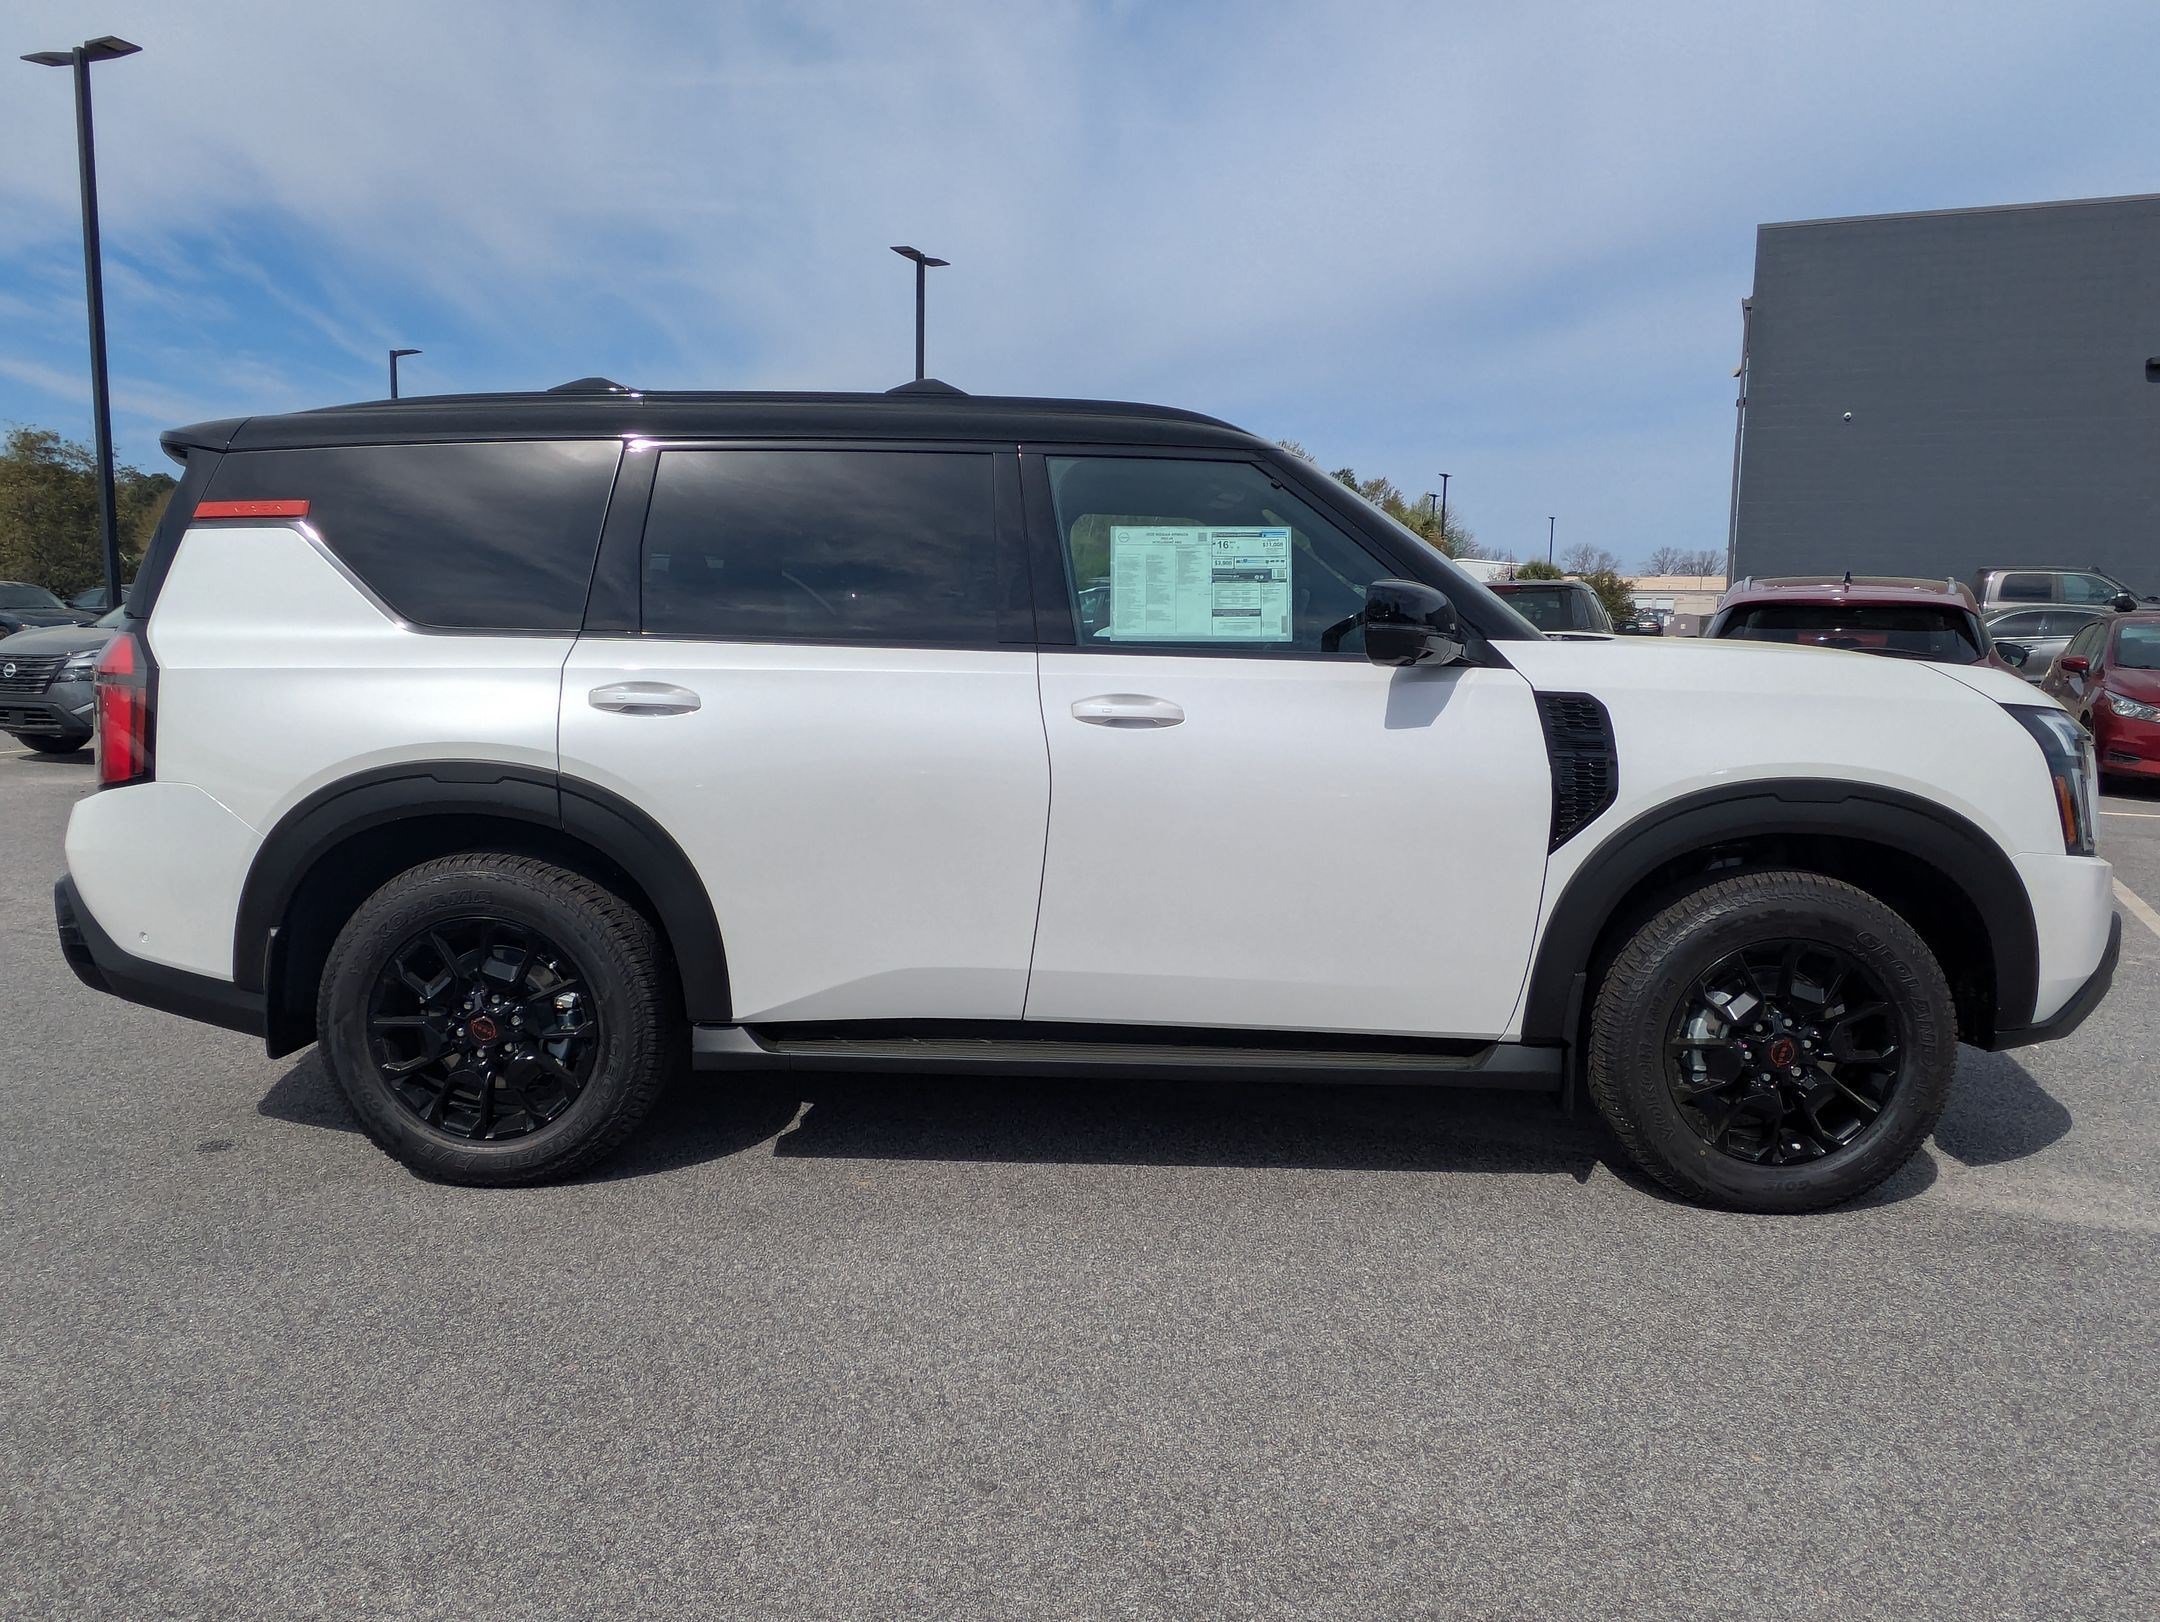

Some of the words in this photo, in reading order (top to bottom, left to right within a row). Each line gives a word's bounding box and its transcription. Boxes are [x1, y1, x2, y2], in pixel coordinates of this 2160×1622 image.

[1217, 540, 1229, 549] 16
[349, 889, 493, 975] YOKOHAMA
[489, 1033, 620, 1170] GEOLANDAR
